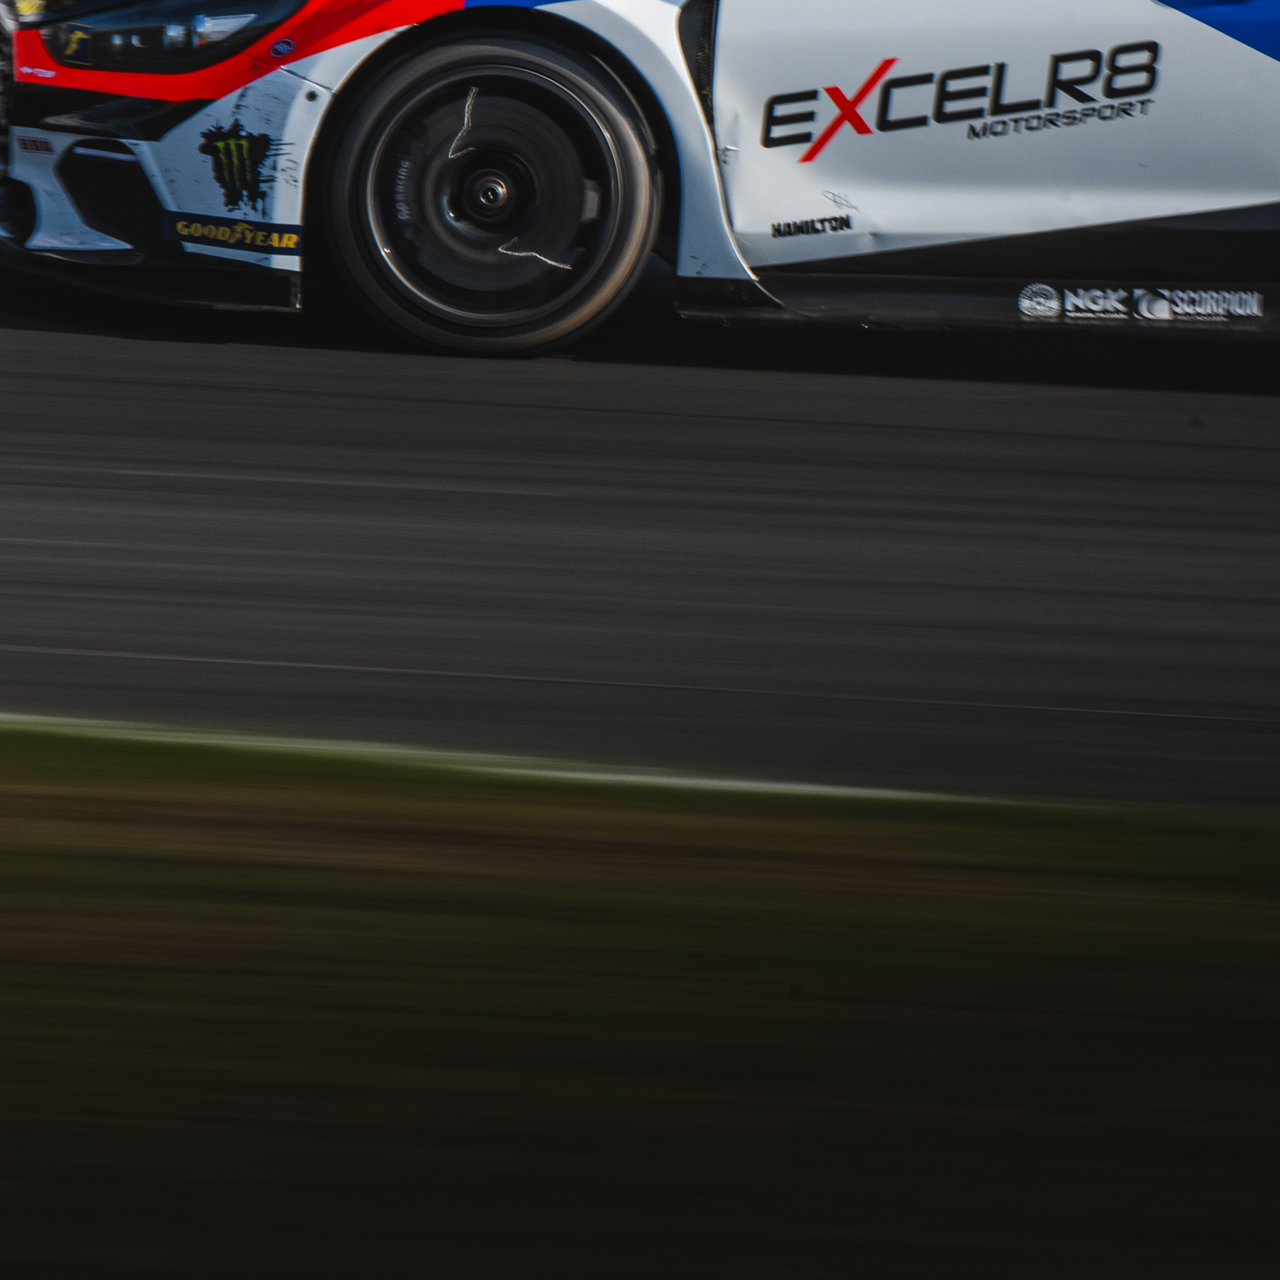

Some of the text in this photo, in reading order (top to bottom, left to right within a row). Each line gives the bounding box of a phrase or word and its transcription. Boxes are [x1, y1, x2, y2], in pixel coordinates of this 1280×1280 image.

[759, 40, 1162, 163] EXCELR8
[966, 98, 1156, 140] MOTORSPORT
[175, 220, 300, 250] GOODYEAR
[770, 214, 853, 238] HAMILTON
[1063, 289, 1130, 313] NGK
[1170, 289, 1265, 317] SCORPION
